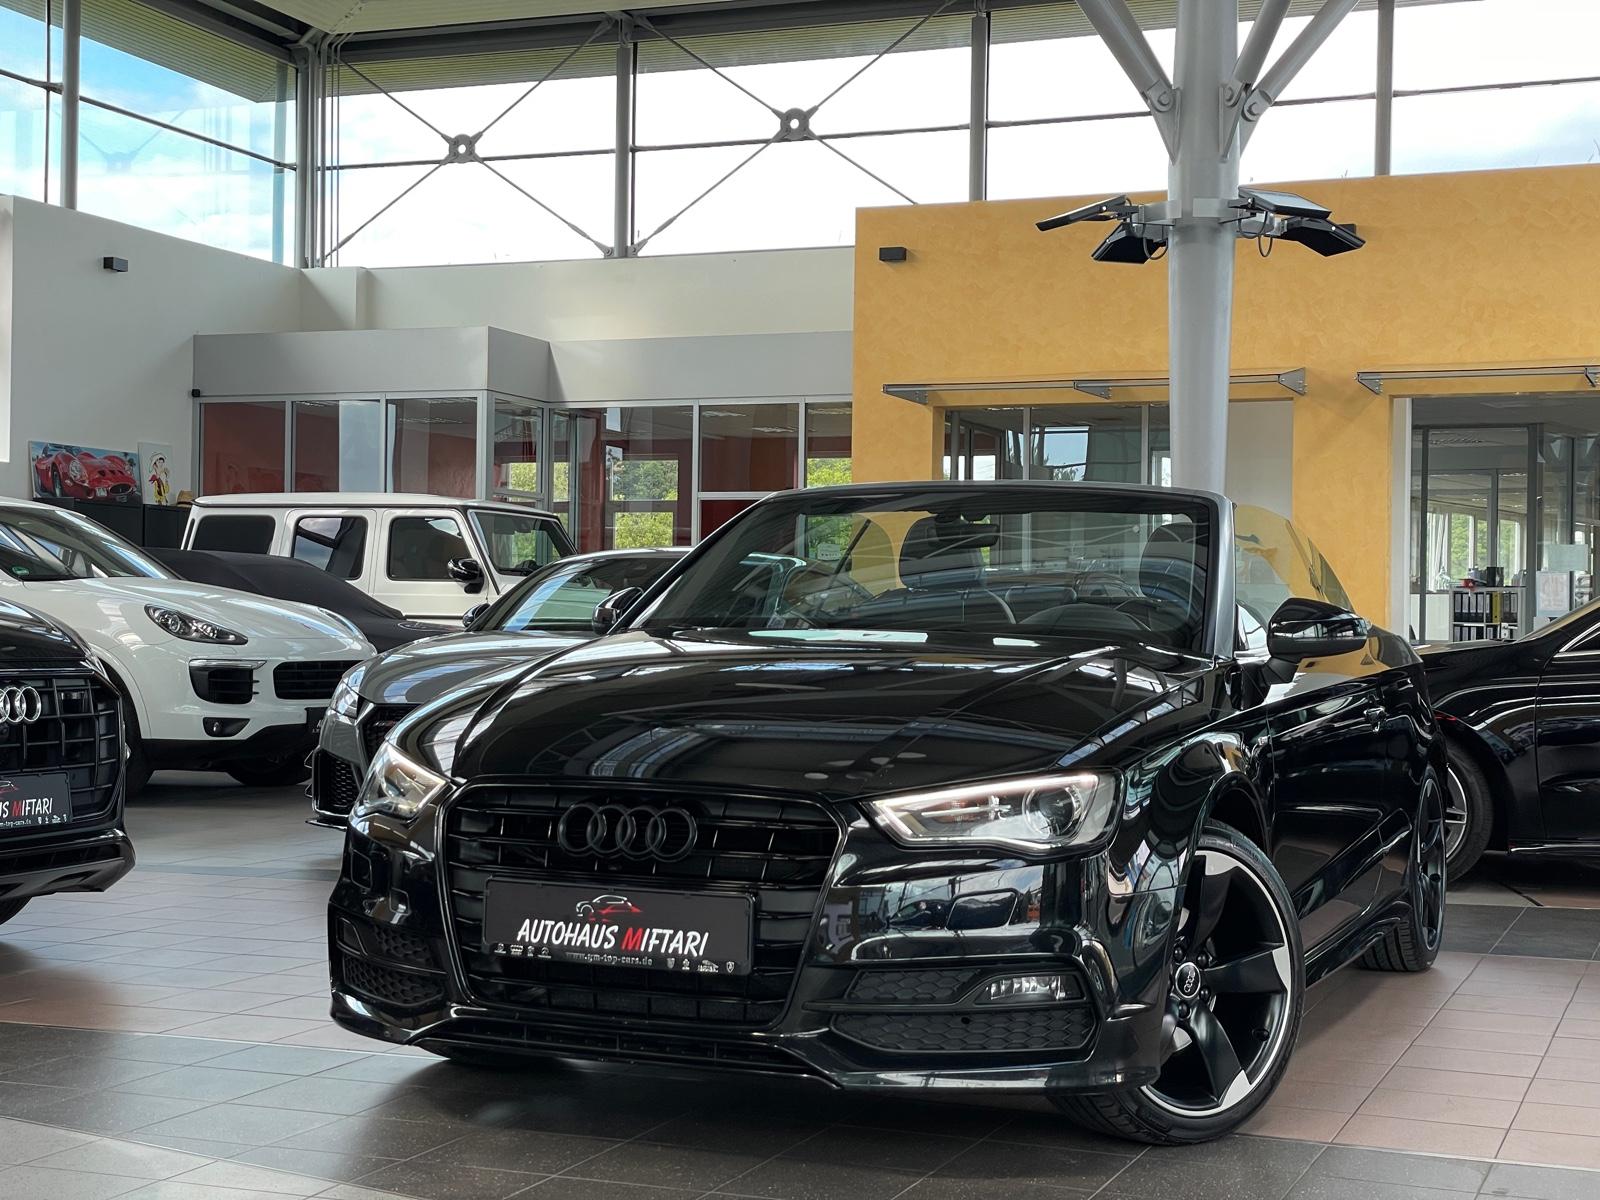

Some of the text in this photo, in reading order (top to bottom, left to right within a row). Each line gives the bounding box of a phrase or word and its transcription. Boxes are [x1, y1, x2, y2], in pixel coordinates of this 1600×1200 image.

[12, 797, 53, 817] MIFTARI
[517, 918, 709, 957] AUTOHAUS MIFTARI
